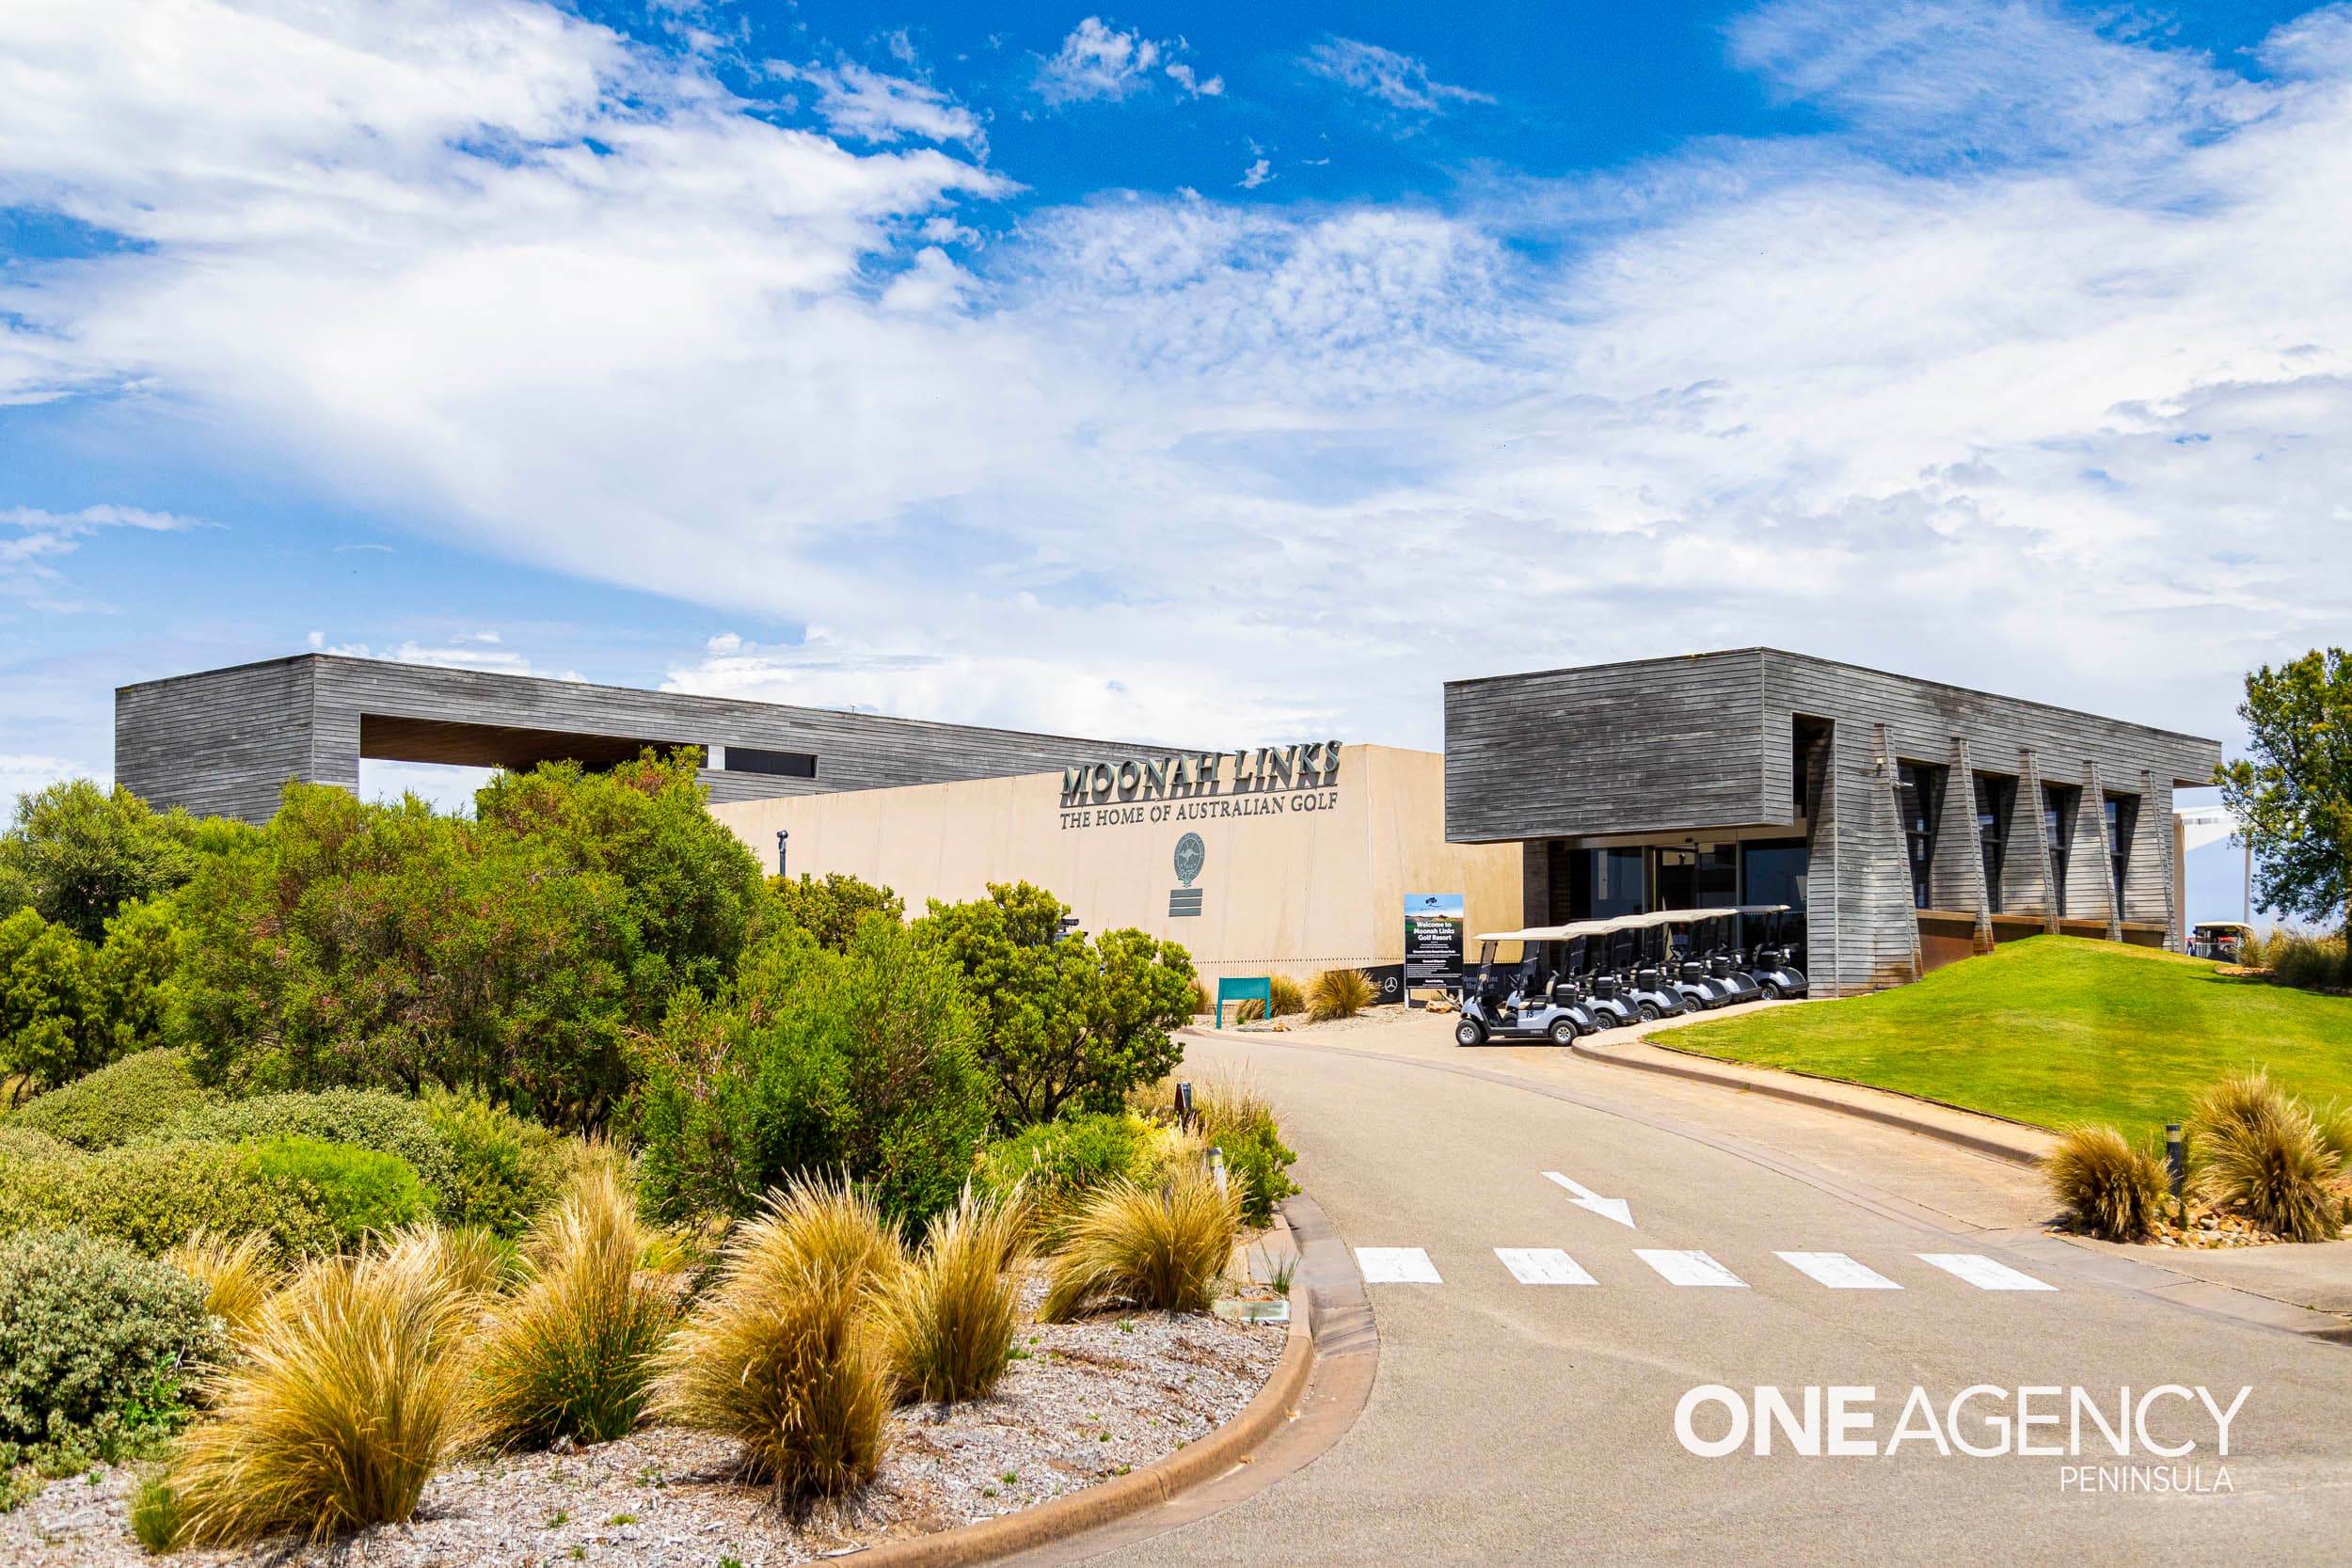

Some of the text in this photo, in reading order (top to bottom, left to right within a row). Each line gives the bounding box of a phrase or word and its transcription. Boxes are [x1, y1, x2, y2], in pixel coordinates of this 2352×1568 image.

[1059, 739, 1343, 796] MOONAH LINKS
[1060, 792, 1338, 830] THE HOME OF AUSTRALIAN GOLF
